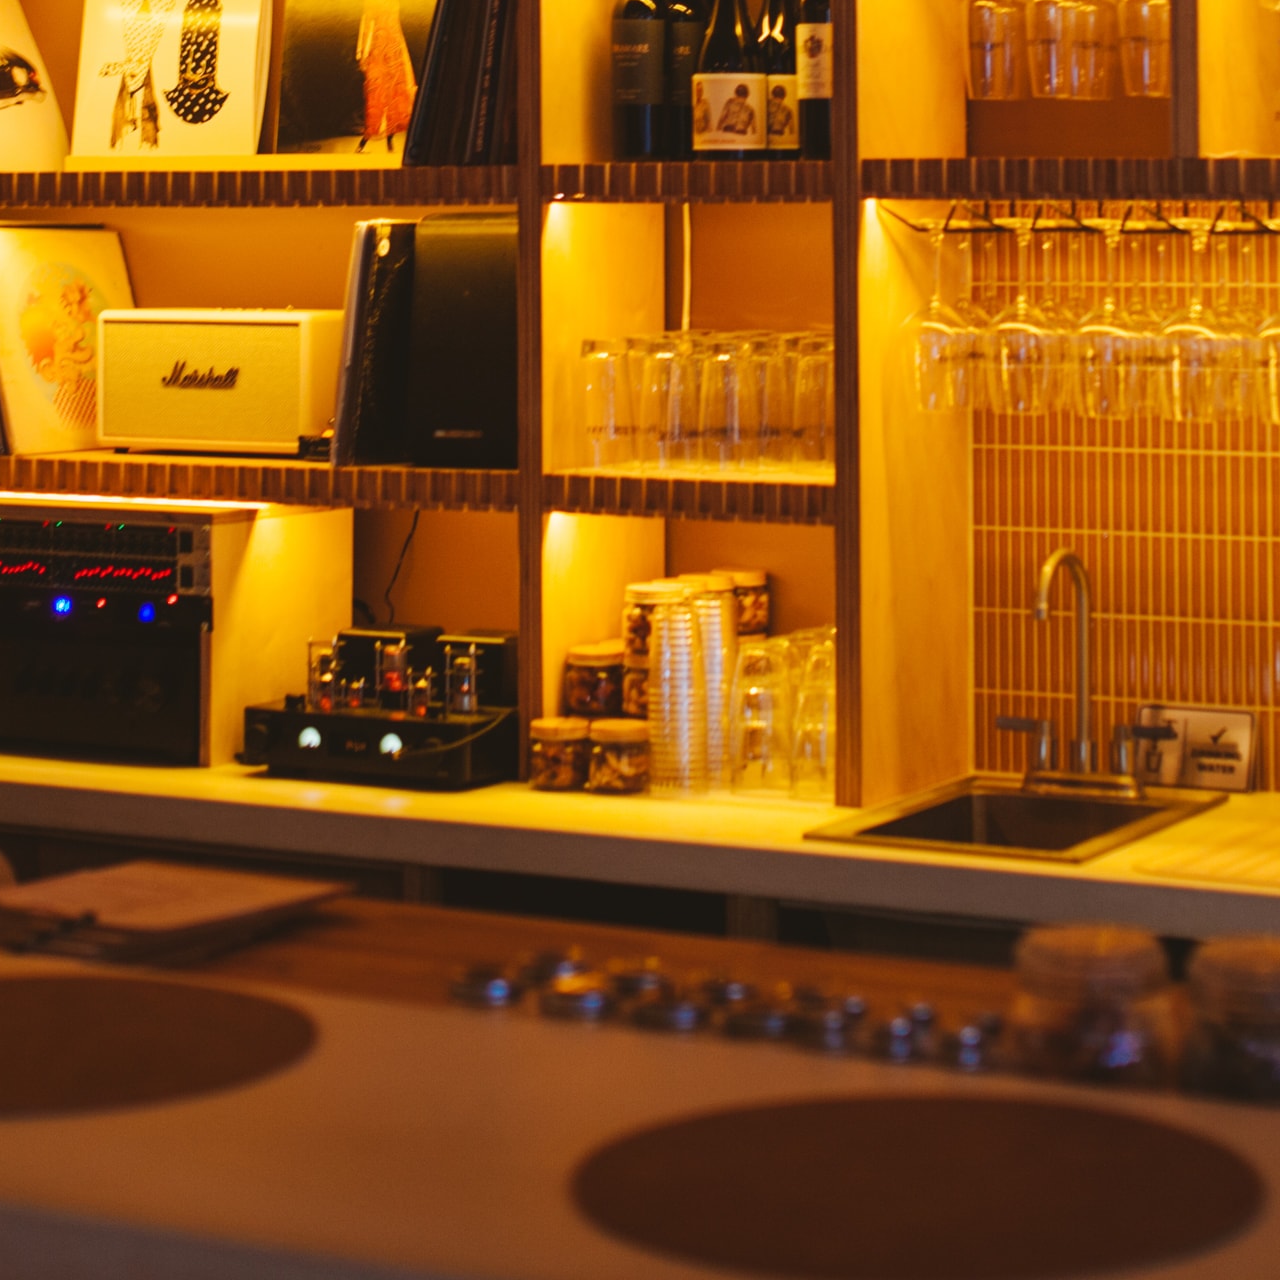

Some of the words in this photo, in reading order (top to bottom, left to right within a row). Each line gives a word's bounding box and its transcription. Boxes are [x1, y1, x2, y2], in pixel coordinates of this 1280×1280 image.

[161, 359, 241, 390] Marshall
[1191, 748, 1243, 762] DRINKING
[1196, 762, 1236, 774] WATER
